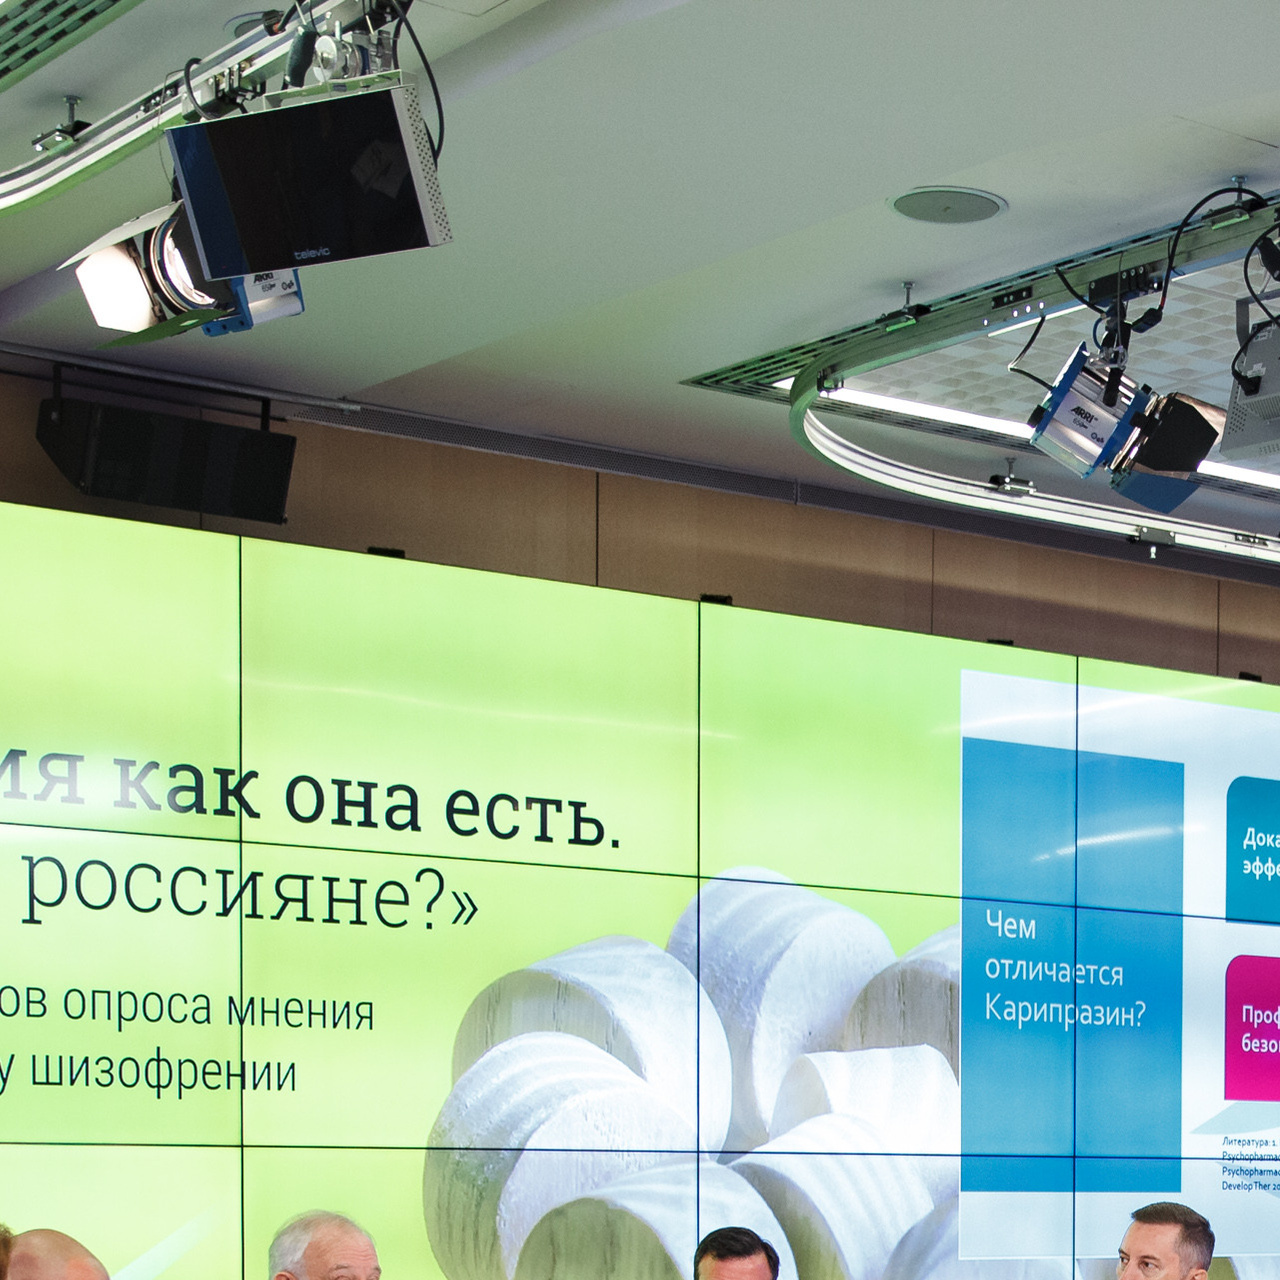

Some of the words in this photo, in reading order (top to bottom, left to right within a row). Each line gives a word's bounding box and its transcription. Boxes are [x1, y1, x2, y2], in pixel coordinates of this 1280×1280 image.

[294, 247, 331, 260] televic
[1070, 406, 1094, 424] ARRI
[113, 757, 260, 819] как
[286, 775, 421, 831] она
[445, 789, 620, 848] есть.
[21, 853, 479, 930] россияне?»
[986, 909, 1036, 940] Чем
[985, 958, 1123, 986] отличается
[0, 985, 47, 1018] ов
[64, 988, 211, 1032] опроса
[228, 993, 374, 1031] мнения
[986, 992, 1147, 1032] Карипразин?
[31, 1046, 296, 1099] шизофрении
[1223, 1136, 1270, 1148] Литература:
[1222, 1181, 1253, 1192] Develop
[1254, 1181, 1271, 1191] Ther
